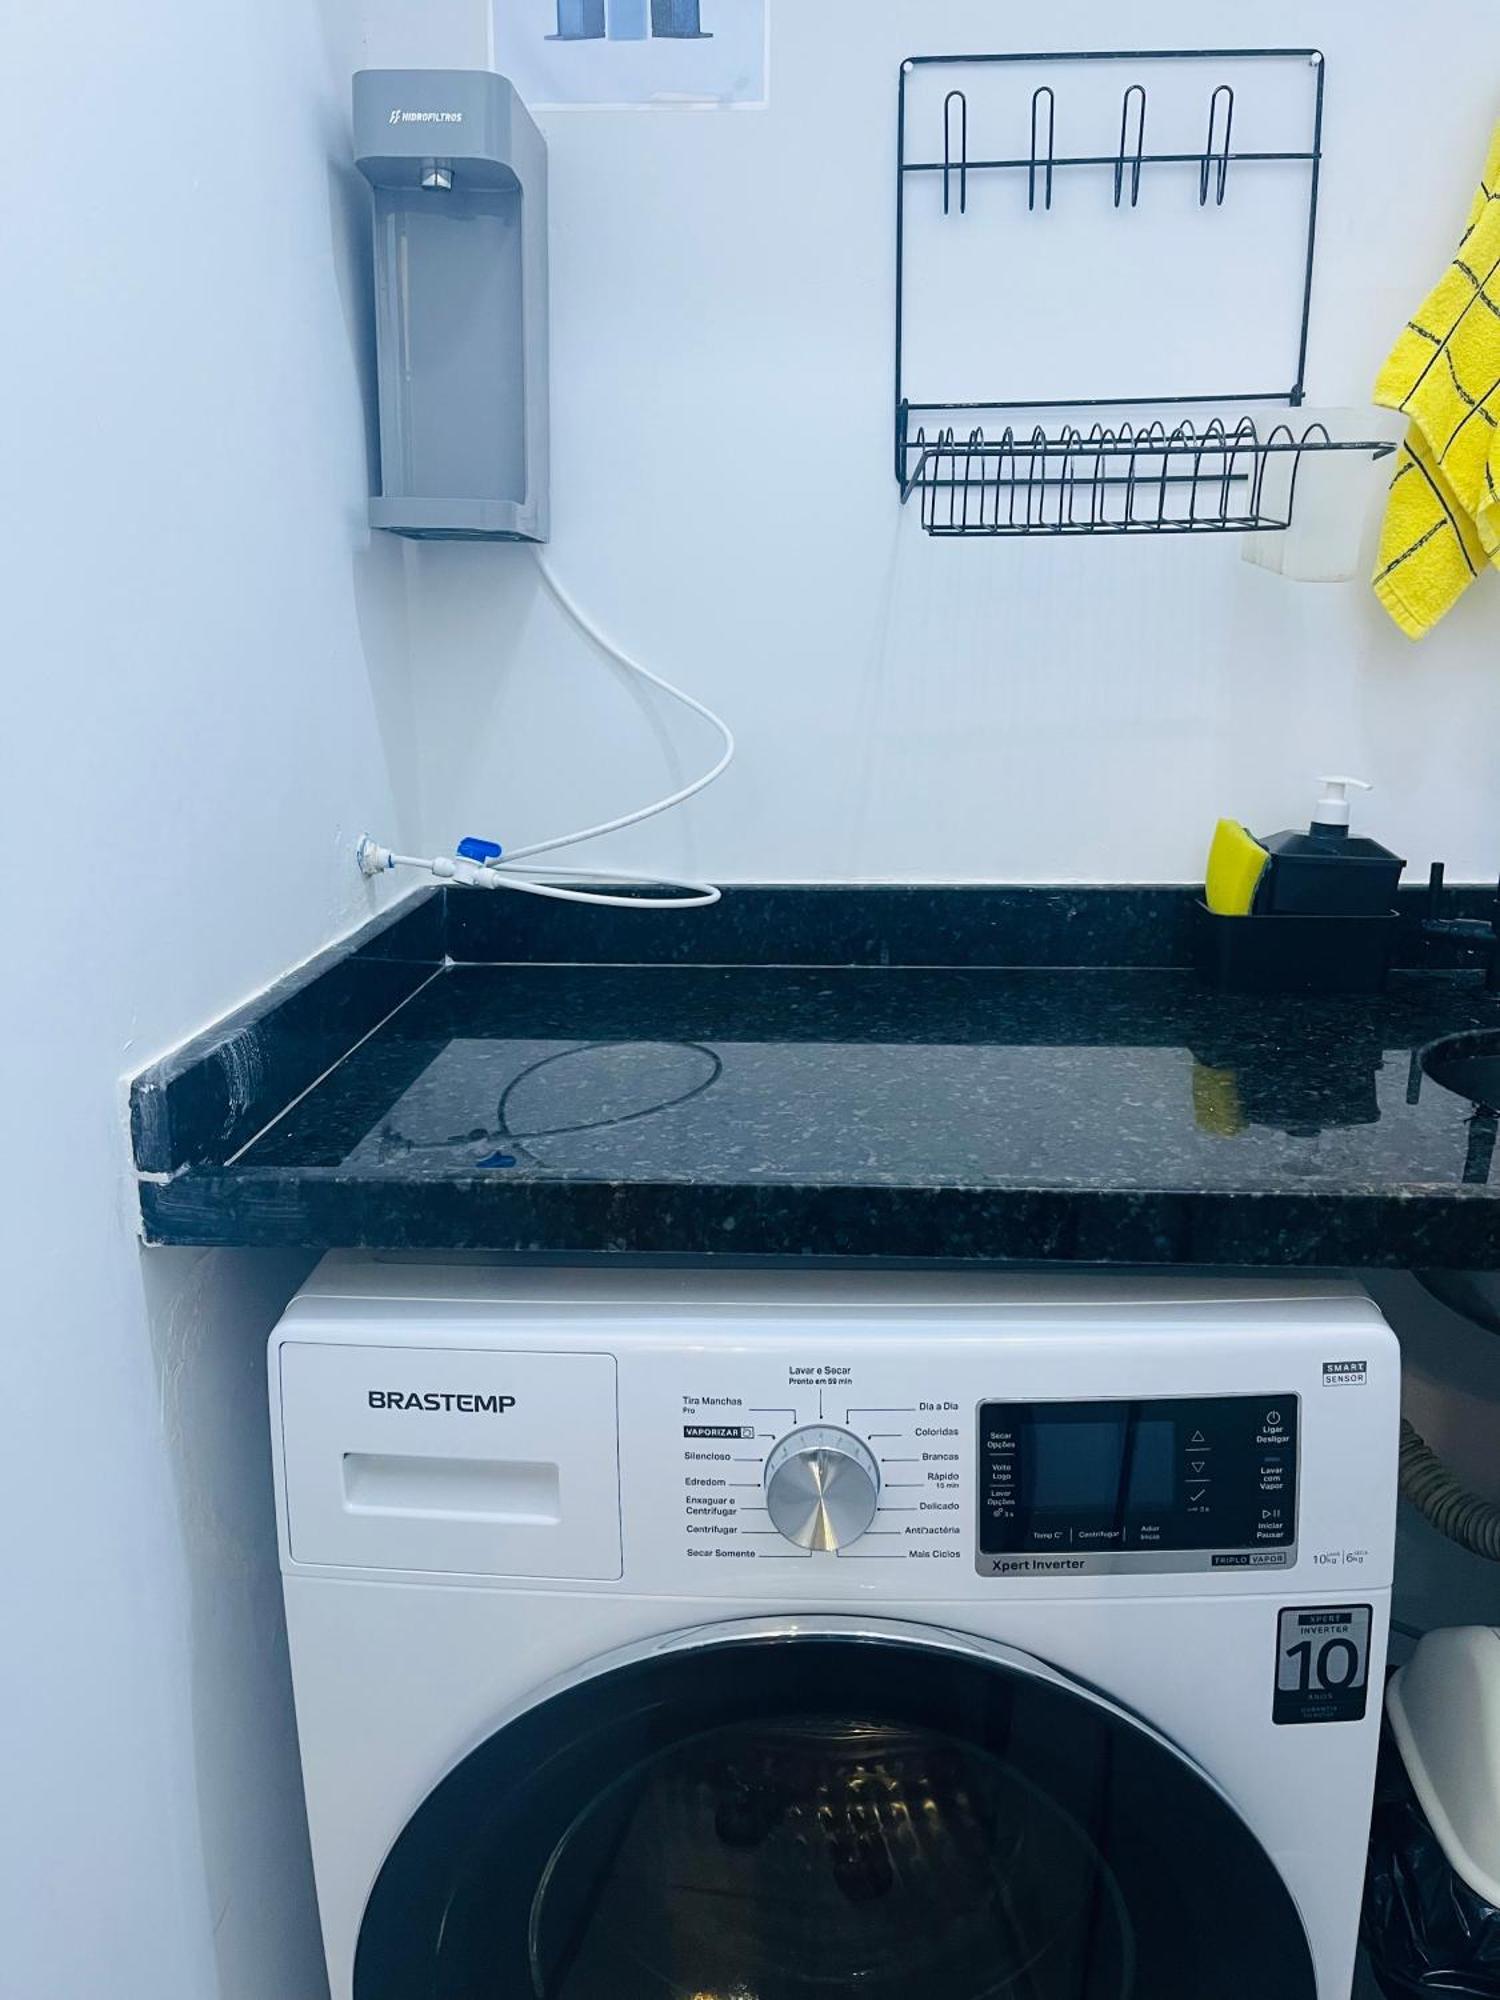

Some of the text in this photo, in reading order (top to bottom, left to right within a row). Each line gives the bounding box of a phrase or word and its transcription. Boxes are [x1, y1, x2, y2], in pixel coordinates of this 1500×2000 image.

[789, 1366, 815, 1376] Lavar
[824, 1367, 851, 1376] Secar
[1327, 1363, 1365, 1373] SMART
[789, 1378, 814, 1386] Pronto
[1325, 1374, 1364, 1384] SENSOR
[368, 1391, 516, 1413] BRASTEMP
[683, 1396, 743, 1407] Tira Manchas
[919, 1401, 959, 1411] Dia a Dia
[683, 1407, 696, 1415] Pro
[686, 1428, 739, 1437] VAPORIZAR
[915, 1427, 960, 1437] Coloridas
[1263, 1425, 1283, 1434] Ligar
[990, 1432, 1012, 1440] Secar
[1256, 1435, 1290, 1444] Desligar
[684, 1452, 731, 1462] Silencioso
[922, 1452, 960, 1462] Brancas
[1260, 1467, 1283, 1475] Lavar
[685, 1477, 726, 1487] Edredom
[927, 1472, 960, 1483] Rápido
[1263, 1475, 1281, 1483] com
[1259, 1482, 1283, 1491] Vapor
[686, 1496, 727, 1506] Enxaguar
[919, 1502, 960, 1511] Delicado
[686, 1507, 737, 1517] Centrifugar
[686, 1525, 738, 1534] Centrifugar
[904, 1526, 960, 1535] Antibactéria
[687, 1549, 756, 1558] Secar Somente
[909, 1549, 961, 1559] Mais Ciclos
[1214, 1553, 1284, 1565] TRIPLO VAPOR
[992, 1559, 1086, 1573] Xpert Inverter
[1300, 1625, 1348, 1635] INVERTER
[1286, 1638, 1359, 1692] 10
